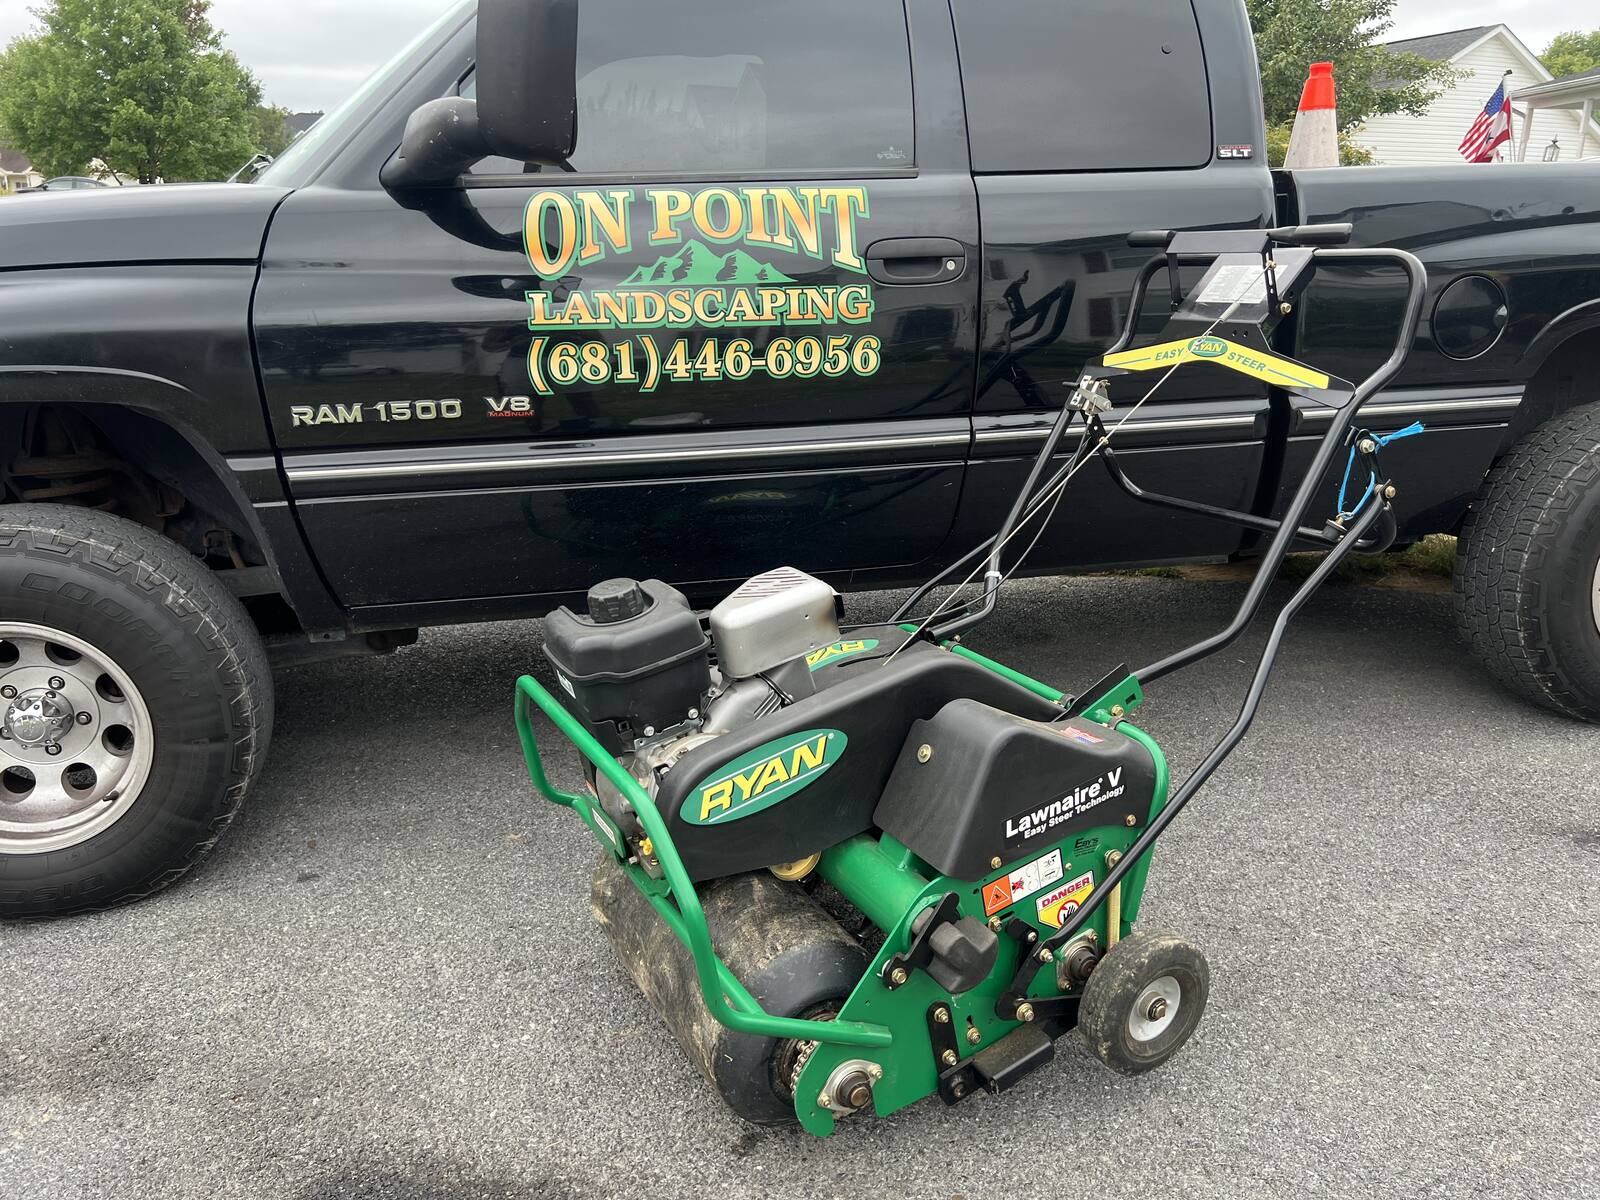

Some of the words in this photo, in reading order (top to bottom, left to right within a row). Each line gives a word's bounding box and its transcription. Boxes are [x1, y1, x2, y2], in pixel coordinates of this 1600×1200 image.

[1219, 149, 1252, 158] SLT
[523, 189, 634, 280] ON
[647, 186, 870, 274] POINT
[526, 285, 874, 330] LANDSCAPING
[527, 335, 881, 394] (681)446-6956
[1154, 347, 1185, 361] EASY
[1227, 351, 1268, 373] STEER
[290, 403, 363, 426] RAM
[374, 398, 462, 422] 1500
[484, 396, 531, 412] V8
[699, 735, 828, 821] RYAN
[1107, 766, 1122, 788] V
[1023, 826, 1048, 840] Easy
[1048, 811, 1073, 828] Steer
[1075, 784, 1125, 815] Technology
[1041, 876, 1090, 908] DANGER
